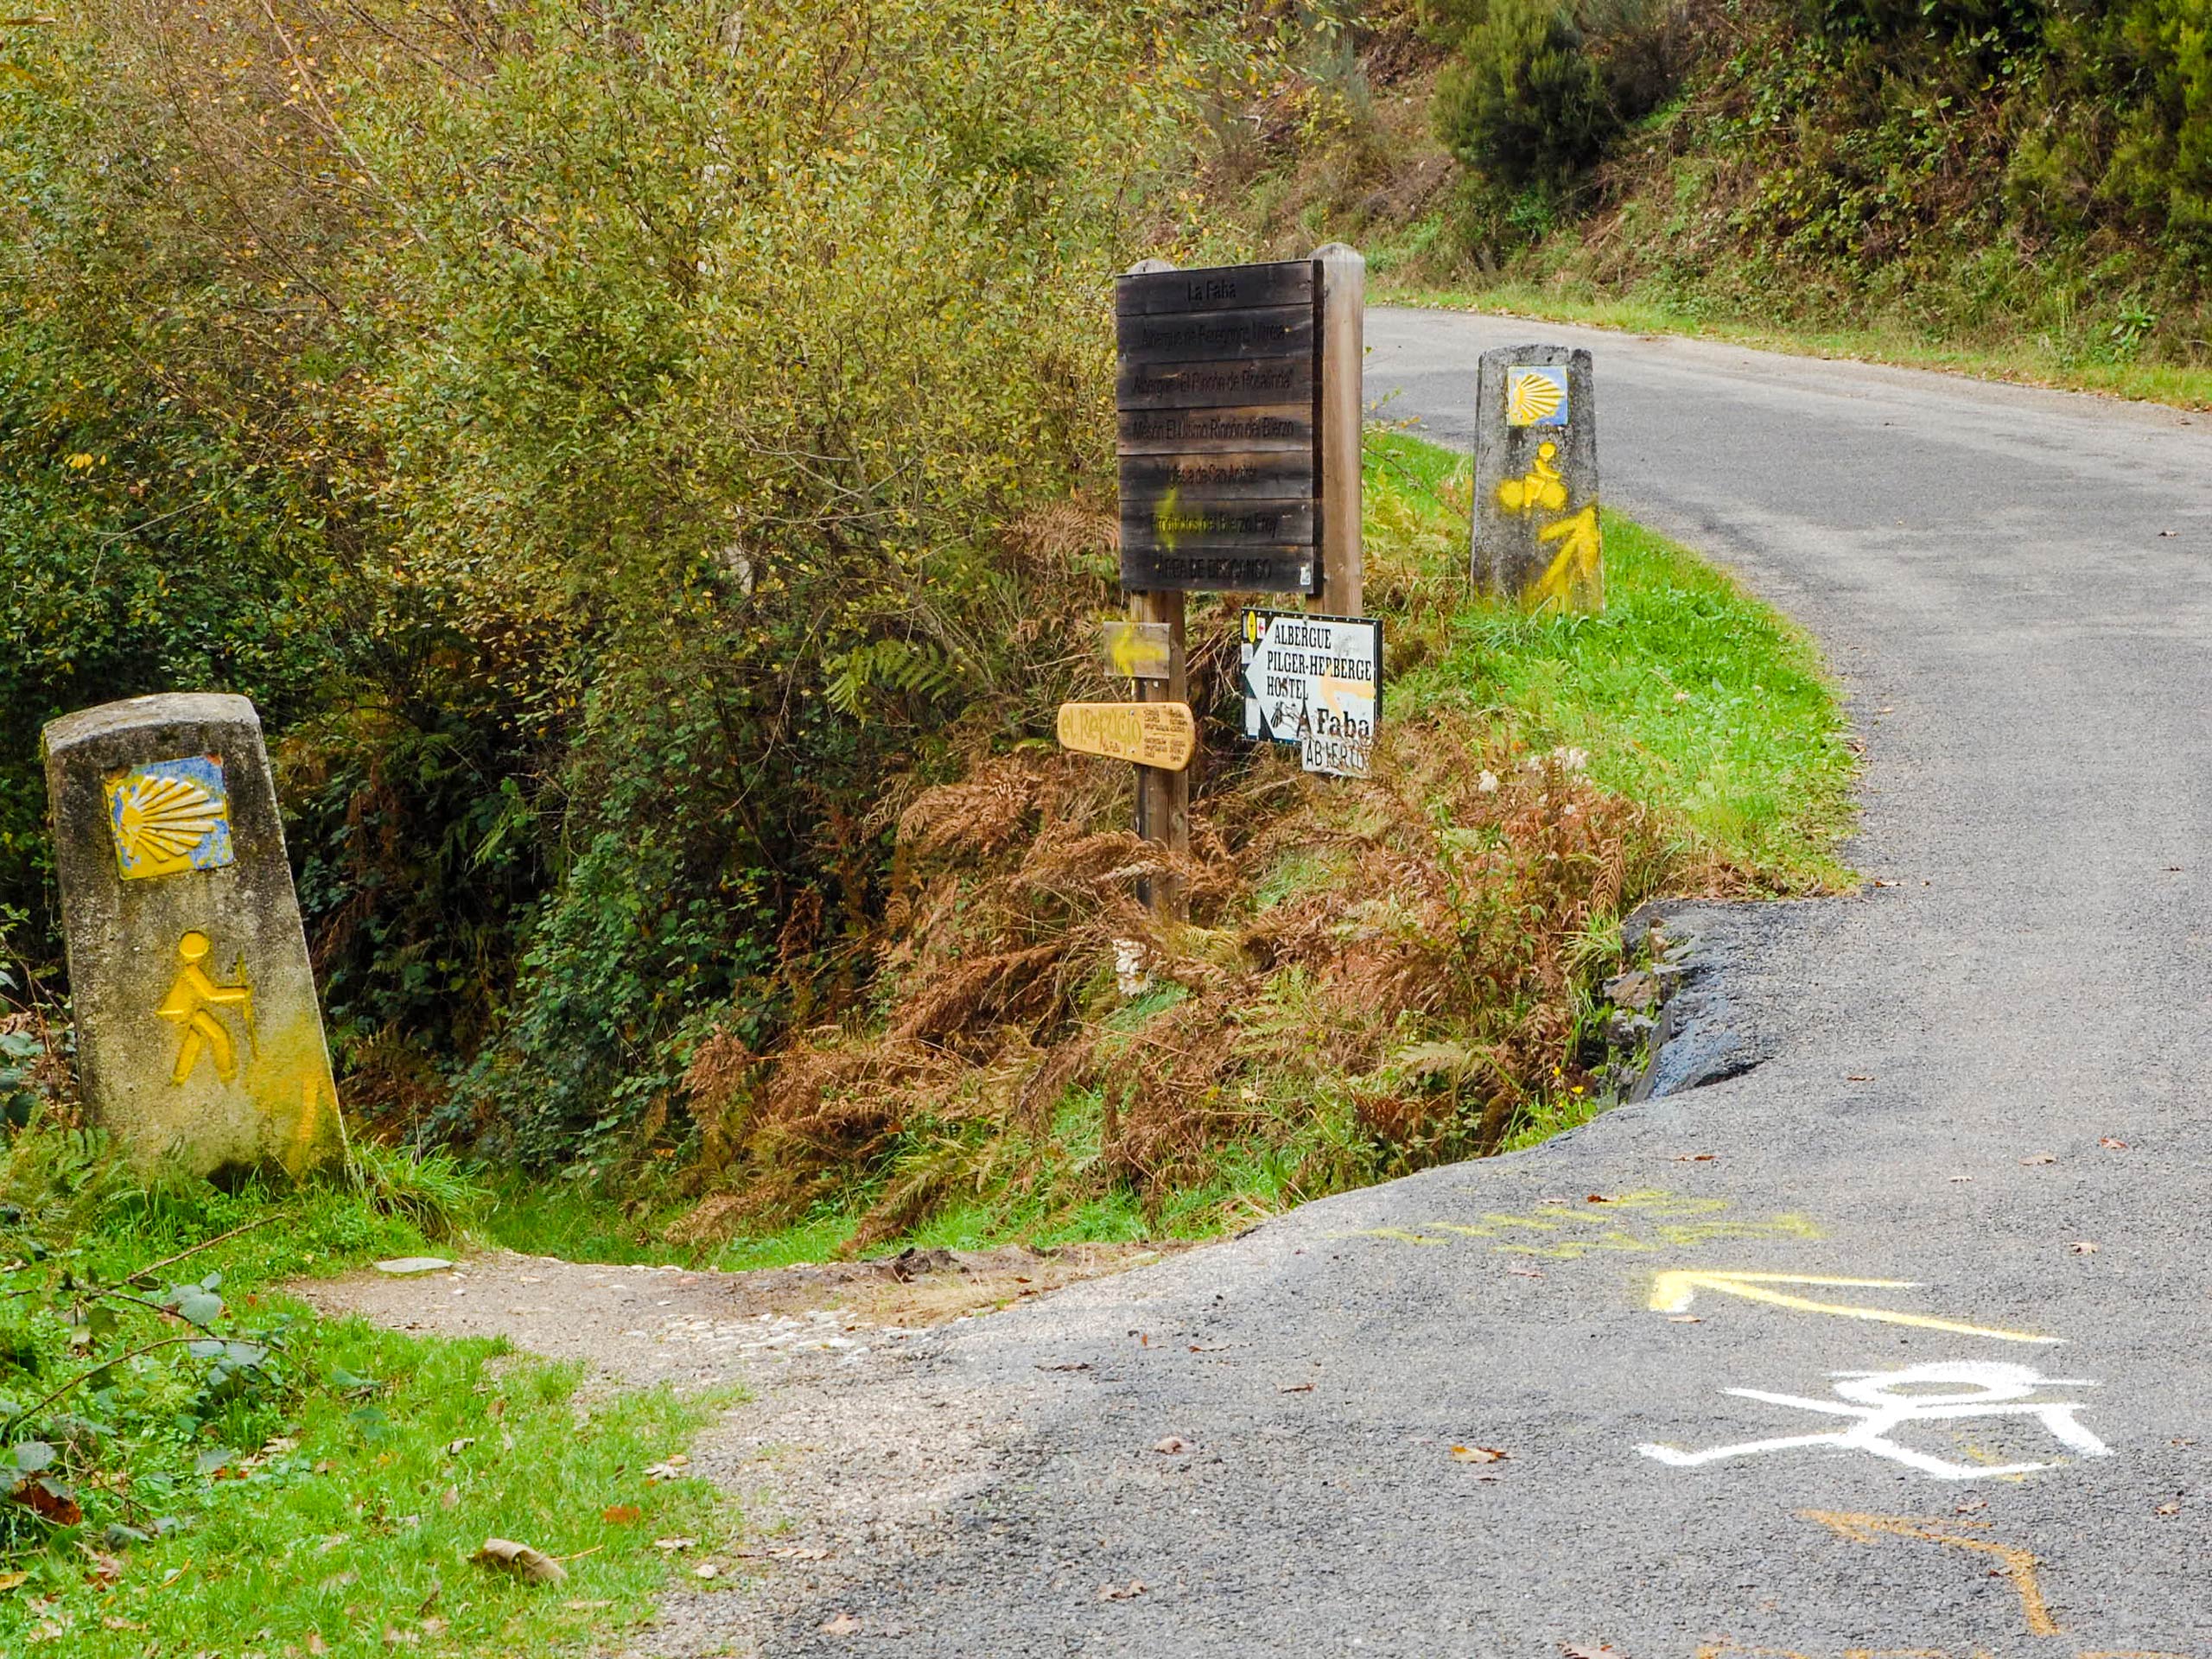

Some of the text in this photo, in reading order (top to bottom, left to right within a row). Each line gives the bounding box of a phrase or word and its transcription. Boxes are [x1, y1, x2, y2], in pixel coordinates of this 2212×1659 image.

[1187, 278, 1236, 302] La Faba
[1262, 417, 1294, 437] Bierzo
[1274, 624, 1332, 650] ALBERGUE
[1267, 676, 1309, 700] HOSTEL
[1316, 708, 1370, 741] Faba
